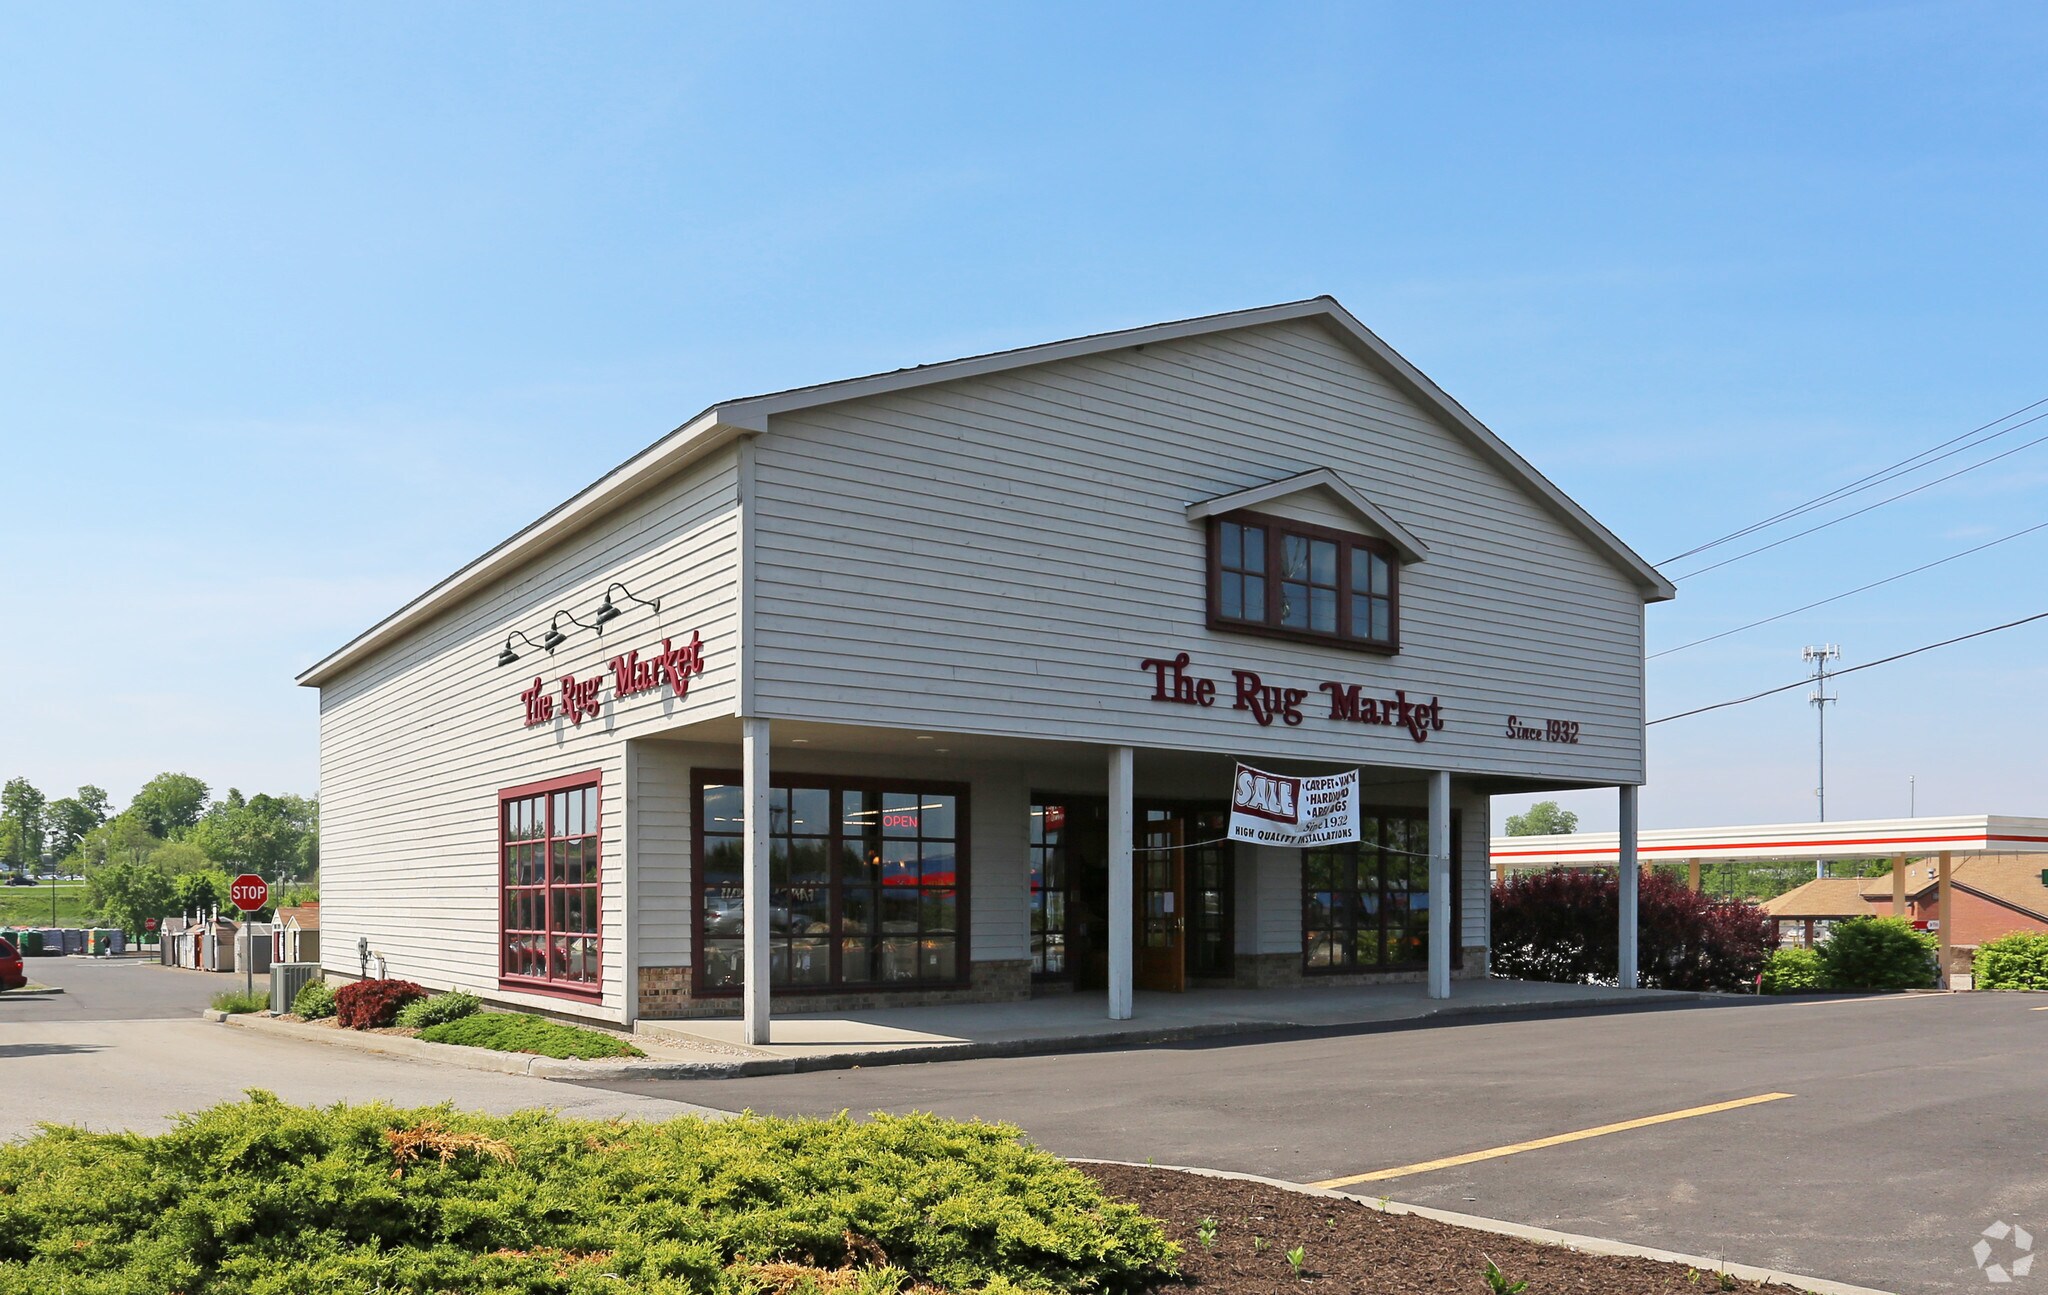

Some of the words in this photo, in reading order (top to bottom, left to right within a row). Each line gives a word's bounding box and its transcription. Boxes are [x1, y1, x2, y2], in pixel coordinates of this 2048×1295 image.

[521, 676, 553, 726] The
[560, 675, 603, 725] Rug
[609, 630, 704, 697] Market
[1141, 652, 1216, 707] The
[1231, 670, 1308, 726] Rug
[1319, 681, 1443, 743] Market
[1506, 715, 1542, 740] Since
[1546, 719, 1579, 744] 1932
[1235, 770, 1296, 817] SALE
[1306, 778, 1334, 791] CARPET
[883, 815, 918, 828] OPEN
[1323, 815, 1348, 829] 1932
[1235, 826, 1254, 838] HIGH
[1258, 831, 1297, 844] QUALITY
[1298, 828, 1352, 844] INSTALLATIONS
[233, 886, 265, 899] STOP
